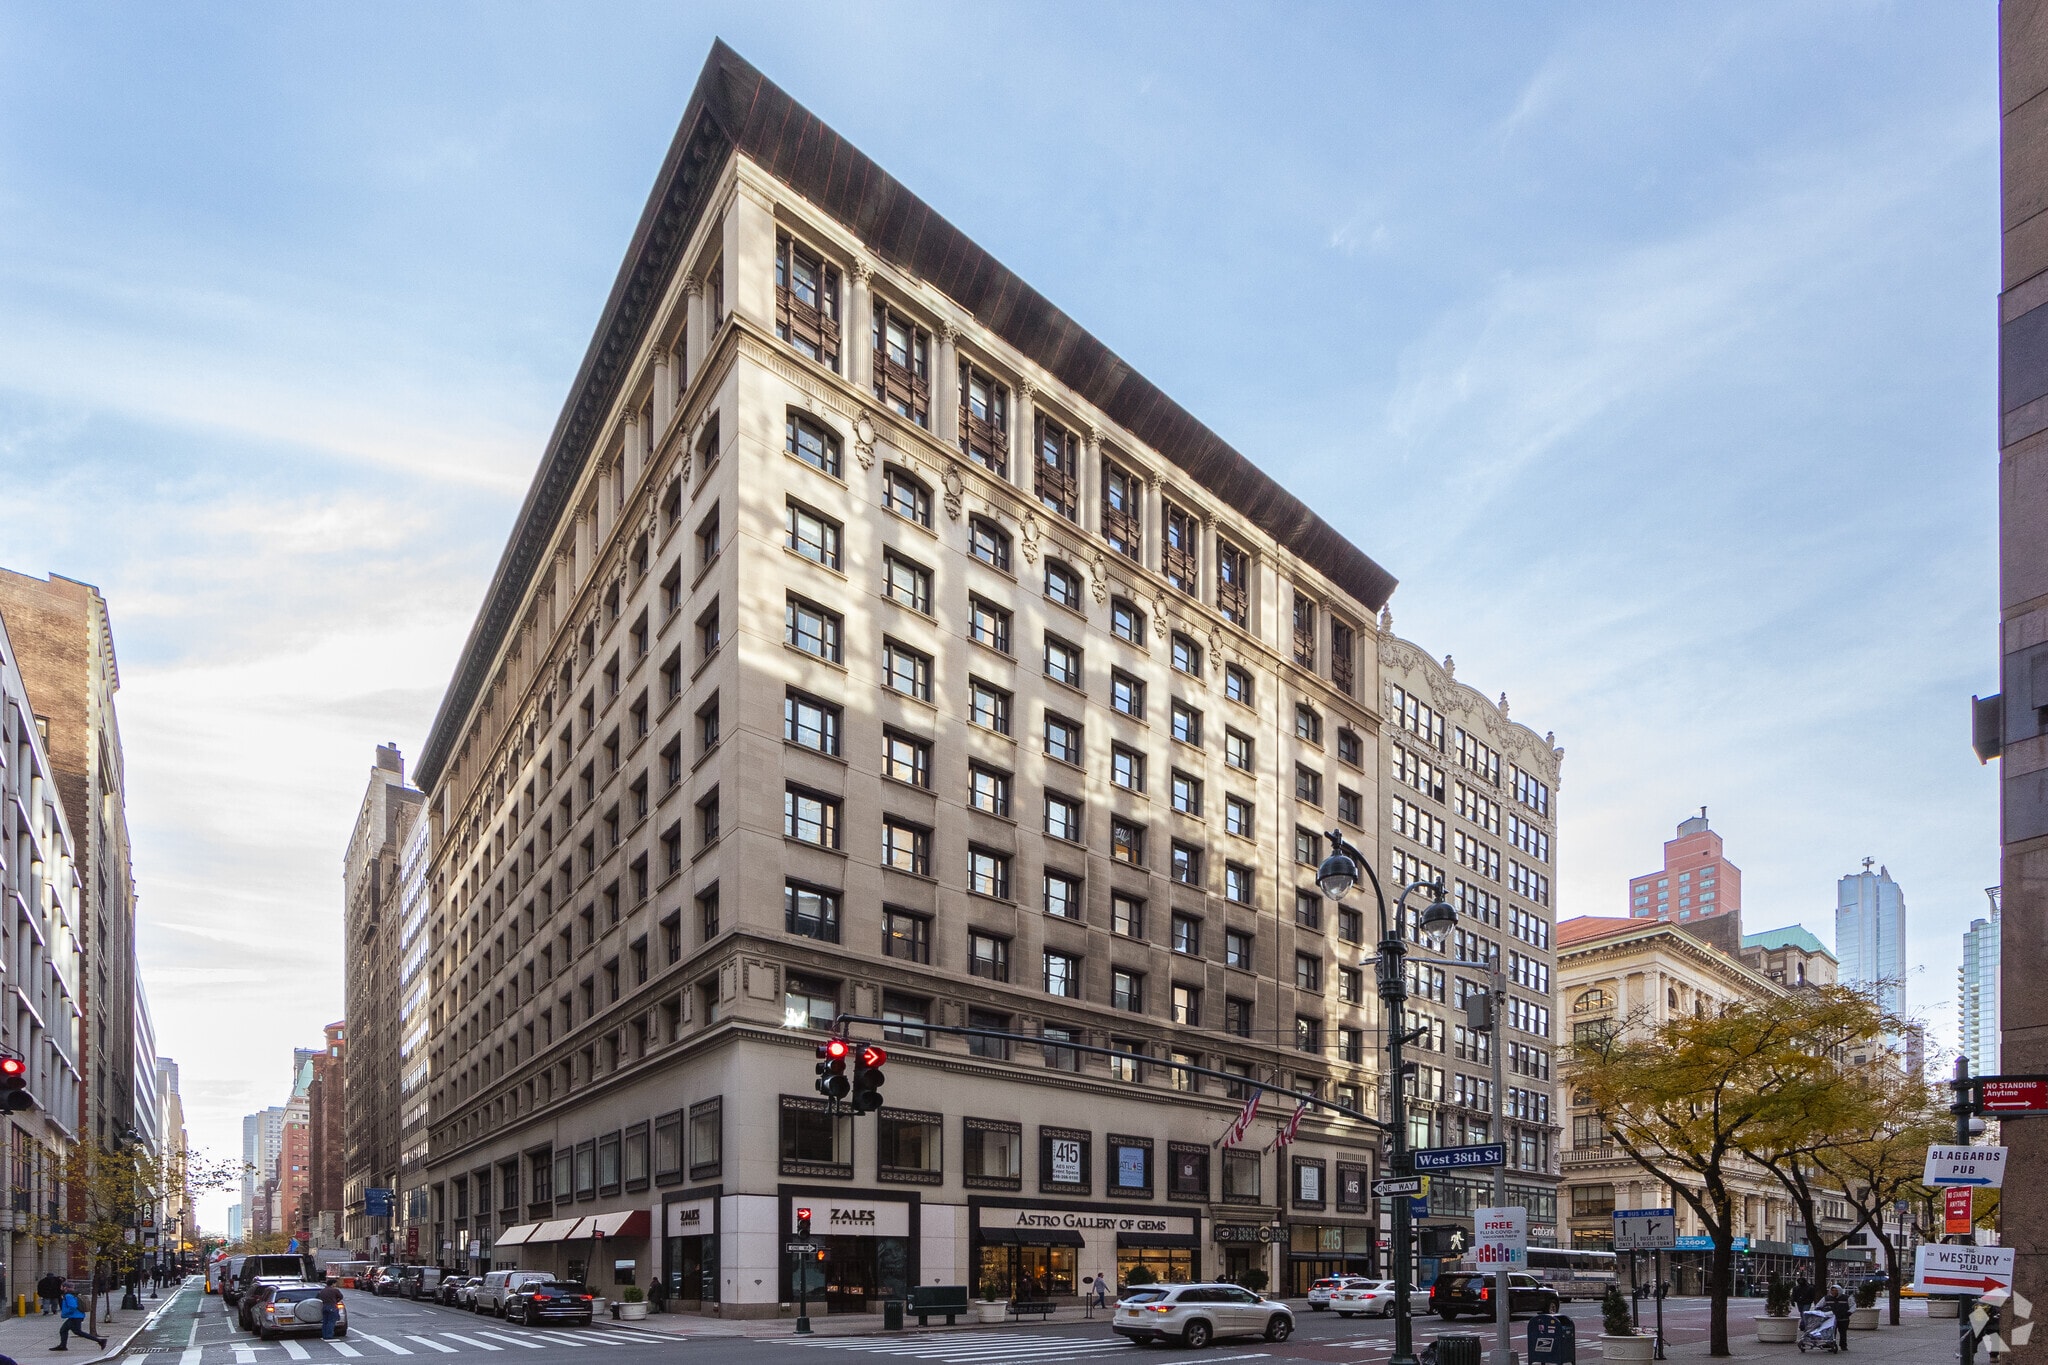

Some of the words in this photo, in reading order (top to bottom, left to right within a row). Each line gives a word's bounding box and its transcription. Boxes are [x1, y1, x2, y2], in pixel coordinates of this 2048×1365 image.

[1056, 1142, 1078, 1163] 415
[1419, 1155, 1450, 1165] West
[1453, 1152, 1481, 1164] 38th
[1485, 1150, 1499, 1160] St
[1952, 1166, 1975, 1174] PUB
[1347, 1181, 1358, 1193] 415
[680, 1209, 699, 1221] ZALES
[831, 1209, 875, 1220] ZALES
[1016, 1211, 1060, 1226] ASTRO
[1063, 1214, 1116, 1230] GALLERY
[1120, 1219, 1135, 1230] OF
[1137, 1220, 1166, 1231] GEMS
[1532, 1227, 1555, 1236] citibank
[1323, 1229, 1340, 1249] 415
[1940, 1252, 1999, 1265] WESTBURY
